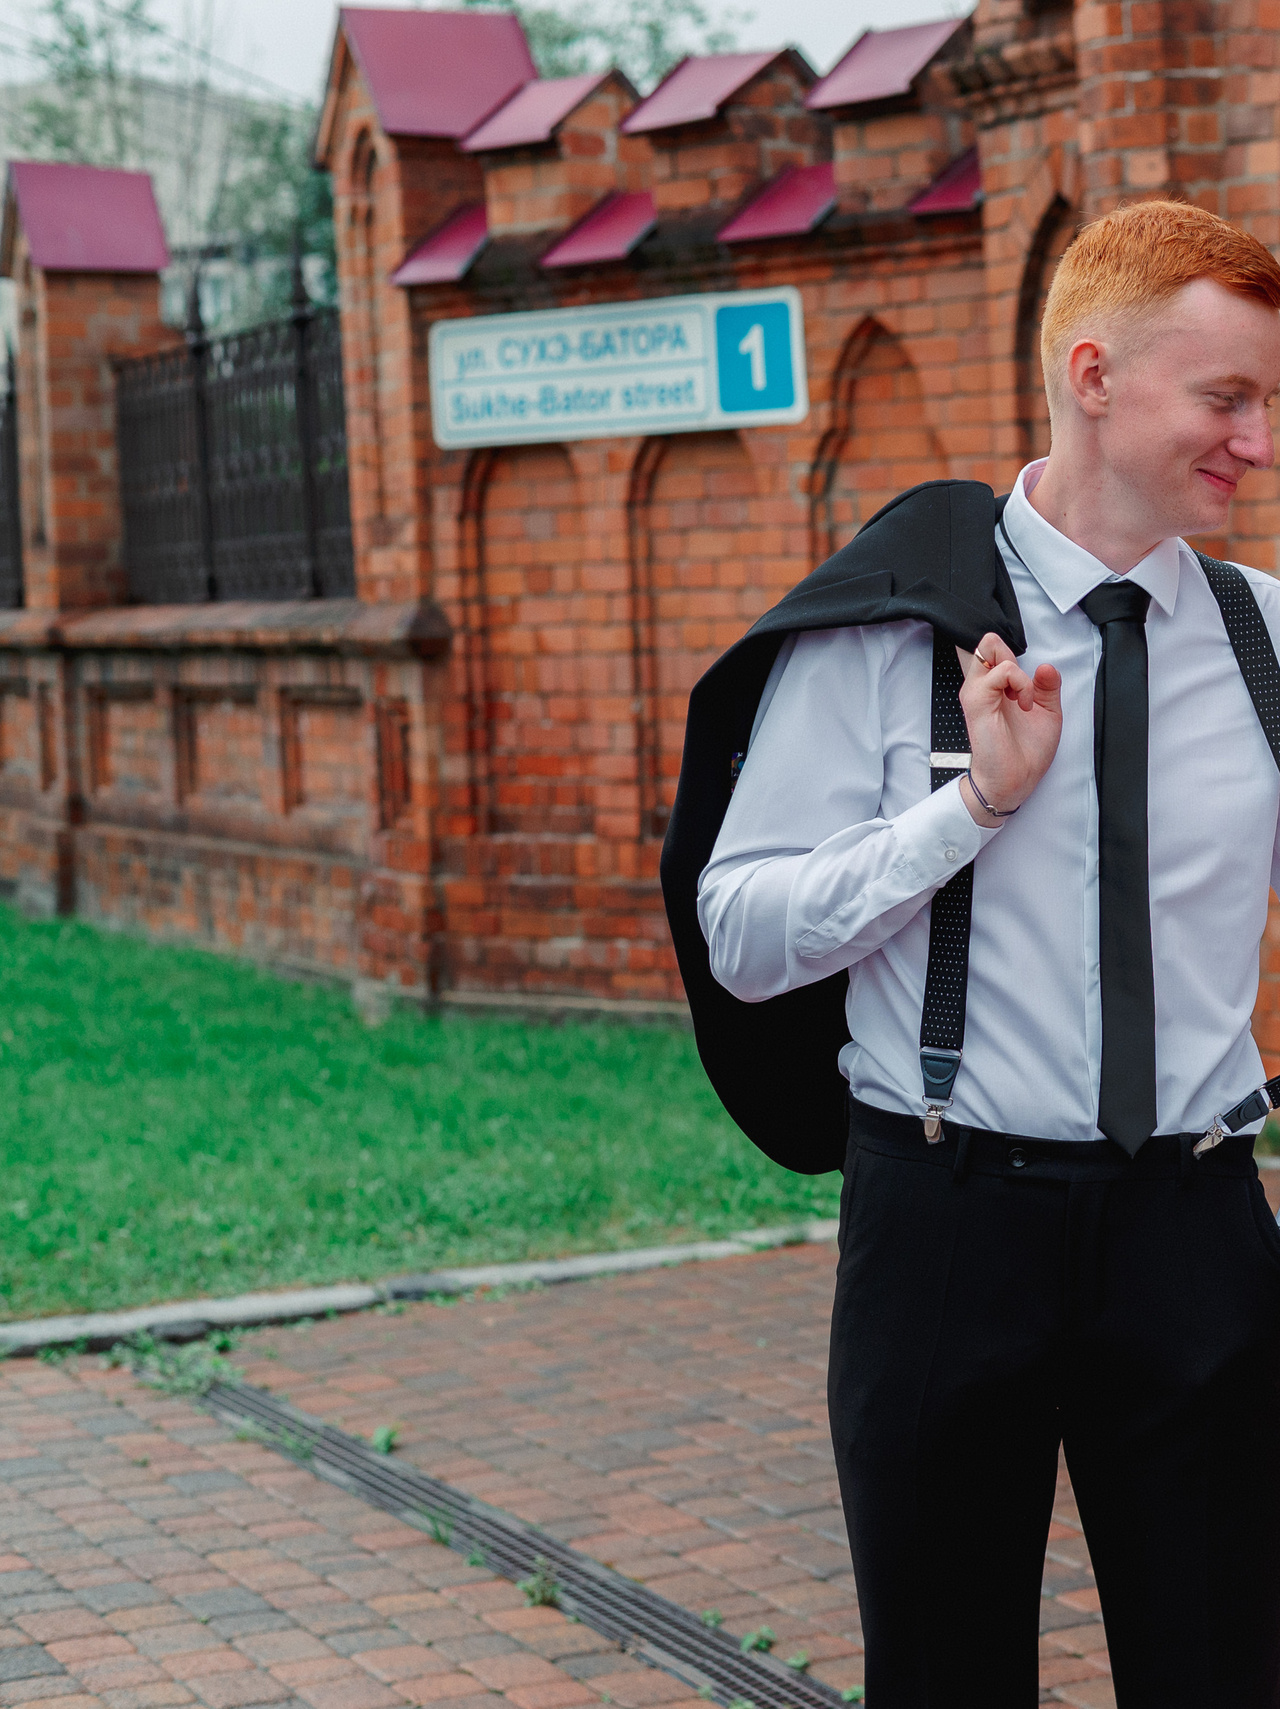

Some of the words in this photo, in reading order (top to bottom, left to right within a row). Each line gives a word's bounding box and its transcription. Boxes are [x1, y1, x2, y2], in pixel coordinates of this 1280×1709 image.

[499, 323, 688, 368] СУХЭ-БАТОРА
[738, 323, 767, 391] 1
[453, 384, 611, 423] Sukhe-Bator
[622, 378, 696, 411] street
